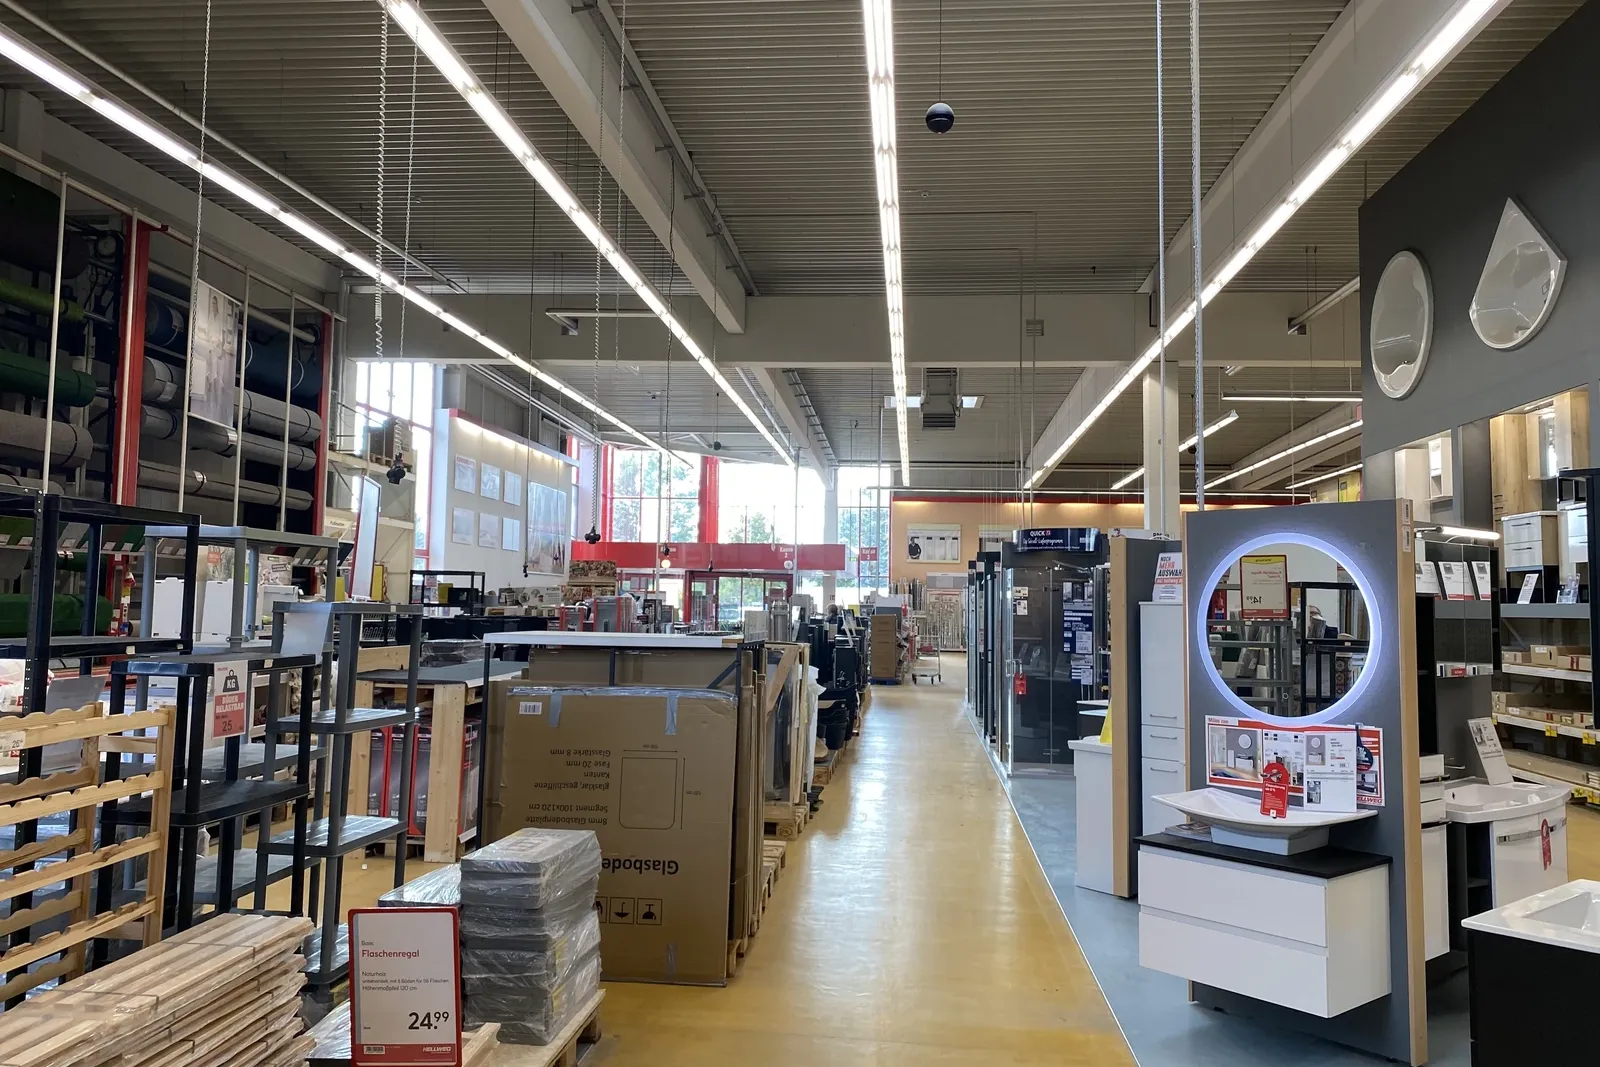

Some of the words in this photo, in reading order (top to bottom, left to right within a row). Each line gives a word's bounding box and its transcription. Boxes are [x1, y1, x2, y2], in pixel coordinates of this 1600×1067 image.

[1159, 561, 1175, 569] MEHR
[227, 679, 235, 688] KG
[222, 695, 238, 704] BÖDEN
[216, 703, 244, 713] BELASTBAR
[222, 721, 232, 731] 25
[573, 749, 611, 757] Glasstärke
[583, 771, 610, 779] Kanten
[534, 781, 579, 791] geschliffene
[580, 782, 610, 791] glasklar,
[541, 803, 573, 812] 100x120
[575, 804, 609, 813] Segment
[525, 815, 586, 825] Glasbodenplatte
[588, 817, 608, 825] 8mm
[602, 858, 679, 876] Glasbode
[361, 949, 420, 959] Flaschenregal
[408, 1011, 450, 1030] 24.99
